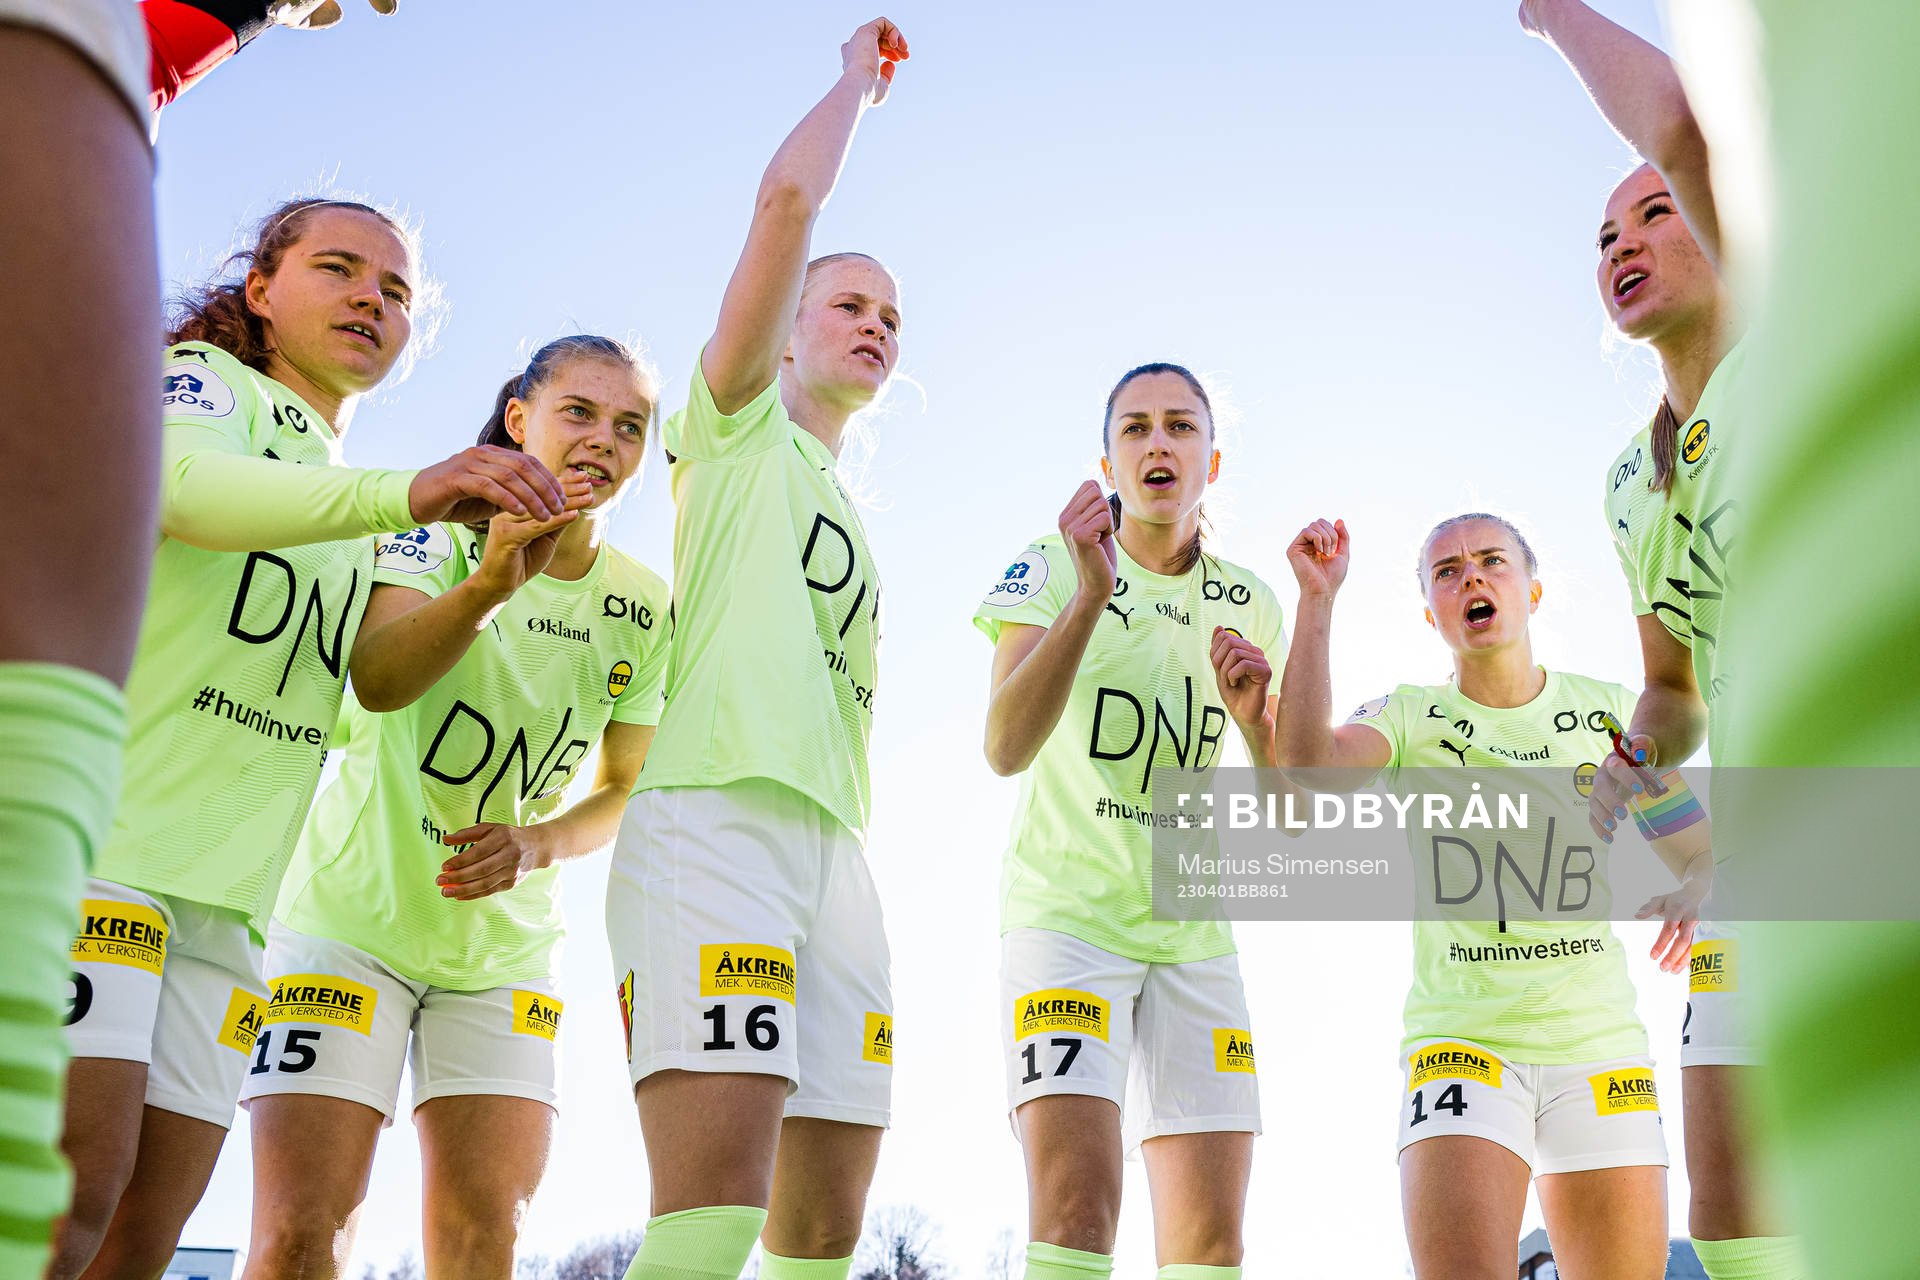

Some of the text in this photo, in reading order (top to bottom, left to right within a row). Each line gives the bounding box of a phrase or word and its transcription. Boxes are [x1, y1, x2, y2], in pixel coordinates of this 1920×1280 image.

[1685, 428, 1708, 456] LSK
[1687, 455, 1710, 482] Kvinner
[375, 543, 428, 563] OBOS
[527, 617, 591, 644] Økland
[610, 674, 629, 685] LSK
[1089, 676, 1225, 794] DNB
[1432, 816, 1596, 933] DNB
[96, 942, 153, 963] VERKSTED
[1449, 937, 1605, 963] #huninvesterer
[715, 950, 795, 985] ÅKRENE
[1709, 974, 1723, 984] AS
[269, 982, 364, 1011] ÅKRENE
[715, 978, 743, 989] MEK.
[746, 978, 790, 995] VERKSTED
[265, 1006, 360, 1025] MEK. VERKSTED AS
[1023, 999, 1102, 1020] ÅKRENE
[525, 1019, 548, 1033] MEK.
[703, 1004, 780, 1051] 16
[1022, 1017, 1101, 1033] MEK. VERKSTED AS
[250, 1029, 322, 1076] 15
[1021, 1037, 1083, 1085] 17
[1414, 1053, 1490, 1074] ÅKRENE
[1431, 1066, 1477, 1076] VERKSTED
[1478, 1071, 1490, 1080] AS
[1410, 1083, 1468, 1128] 14
[1608, 1098, 1632, 1109] MEK.
